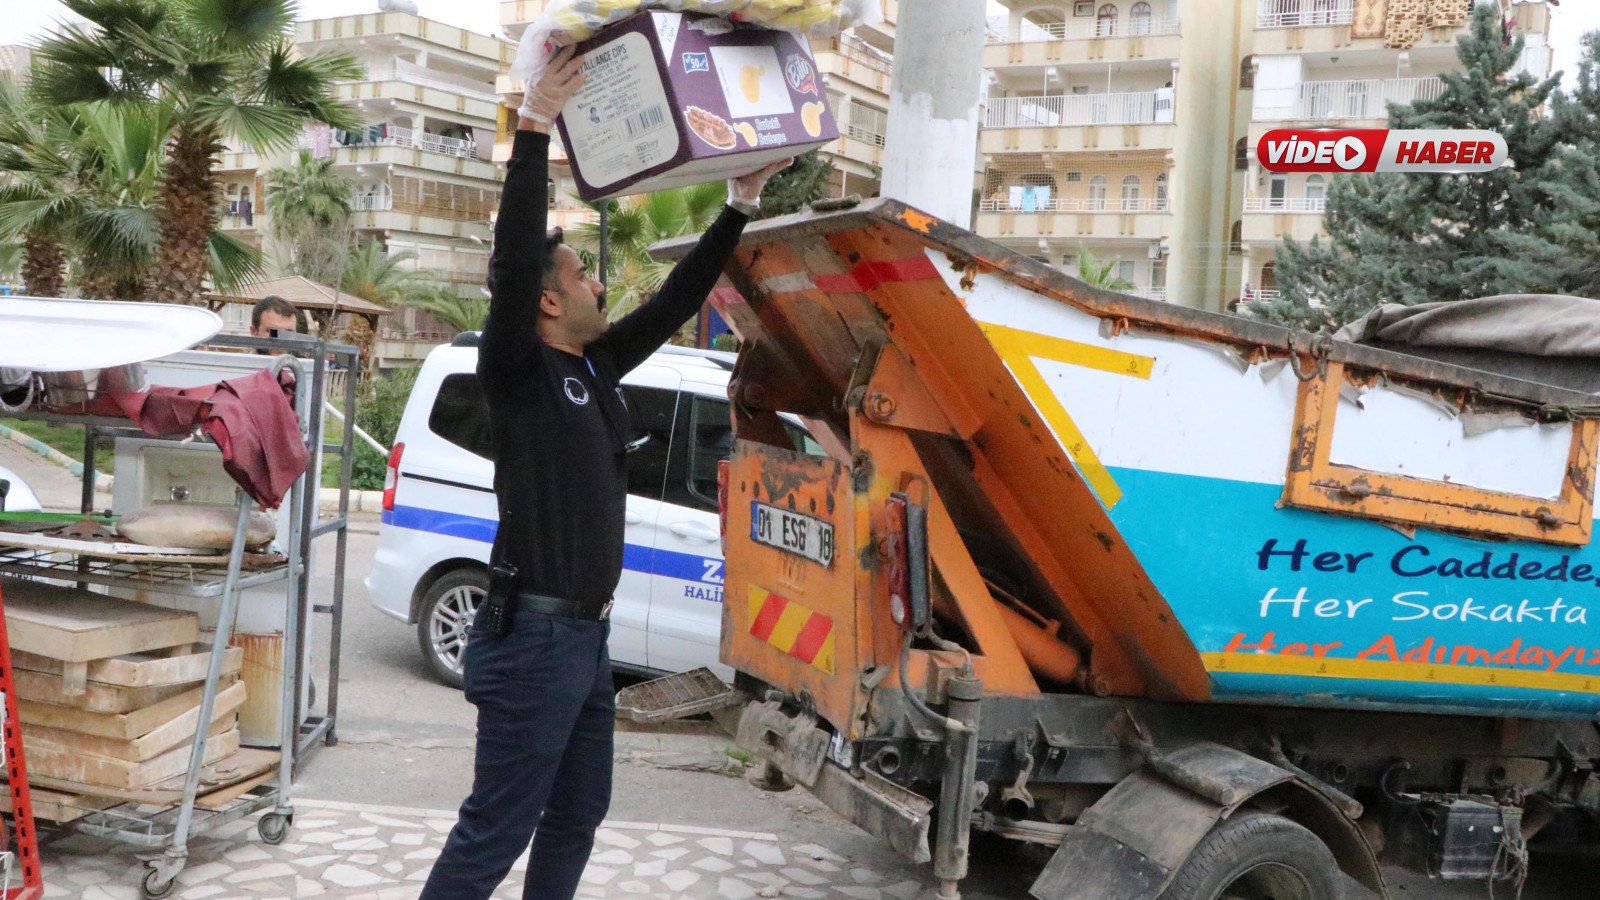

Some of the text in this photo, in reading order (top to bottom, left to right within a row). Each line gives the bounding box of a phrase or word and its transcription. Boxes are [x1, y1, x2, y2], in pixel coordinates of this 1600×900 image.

[758, 508, 772, 541] 01
[818, 525, 832, 561] 18
[1256, 538, 1374, 573] Her
[1259, 587, 1587, 624] Her Sokakta
[1223, 632, 1343, 659] Her
